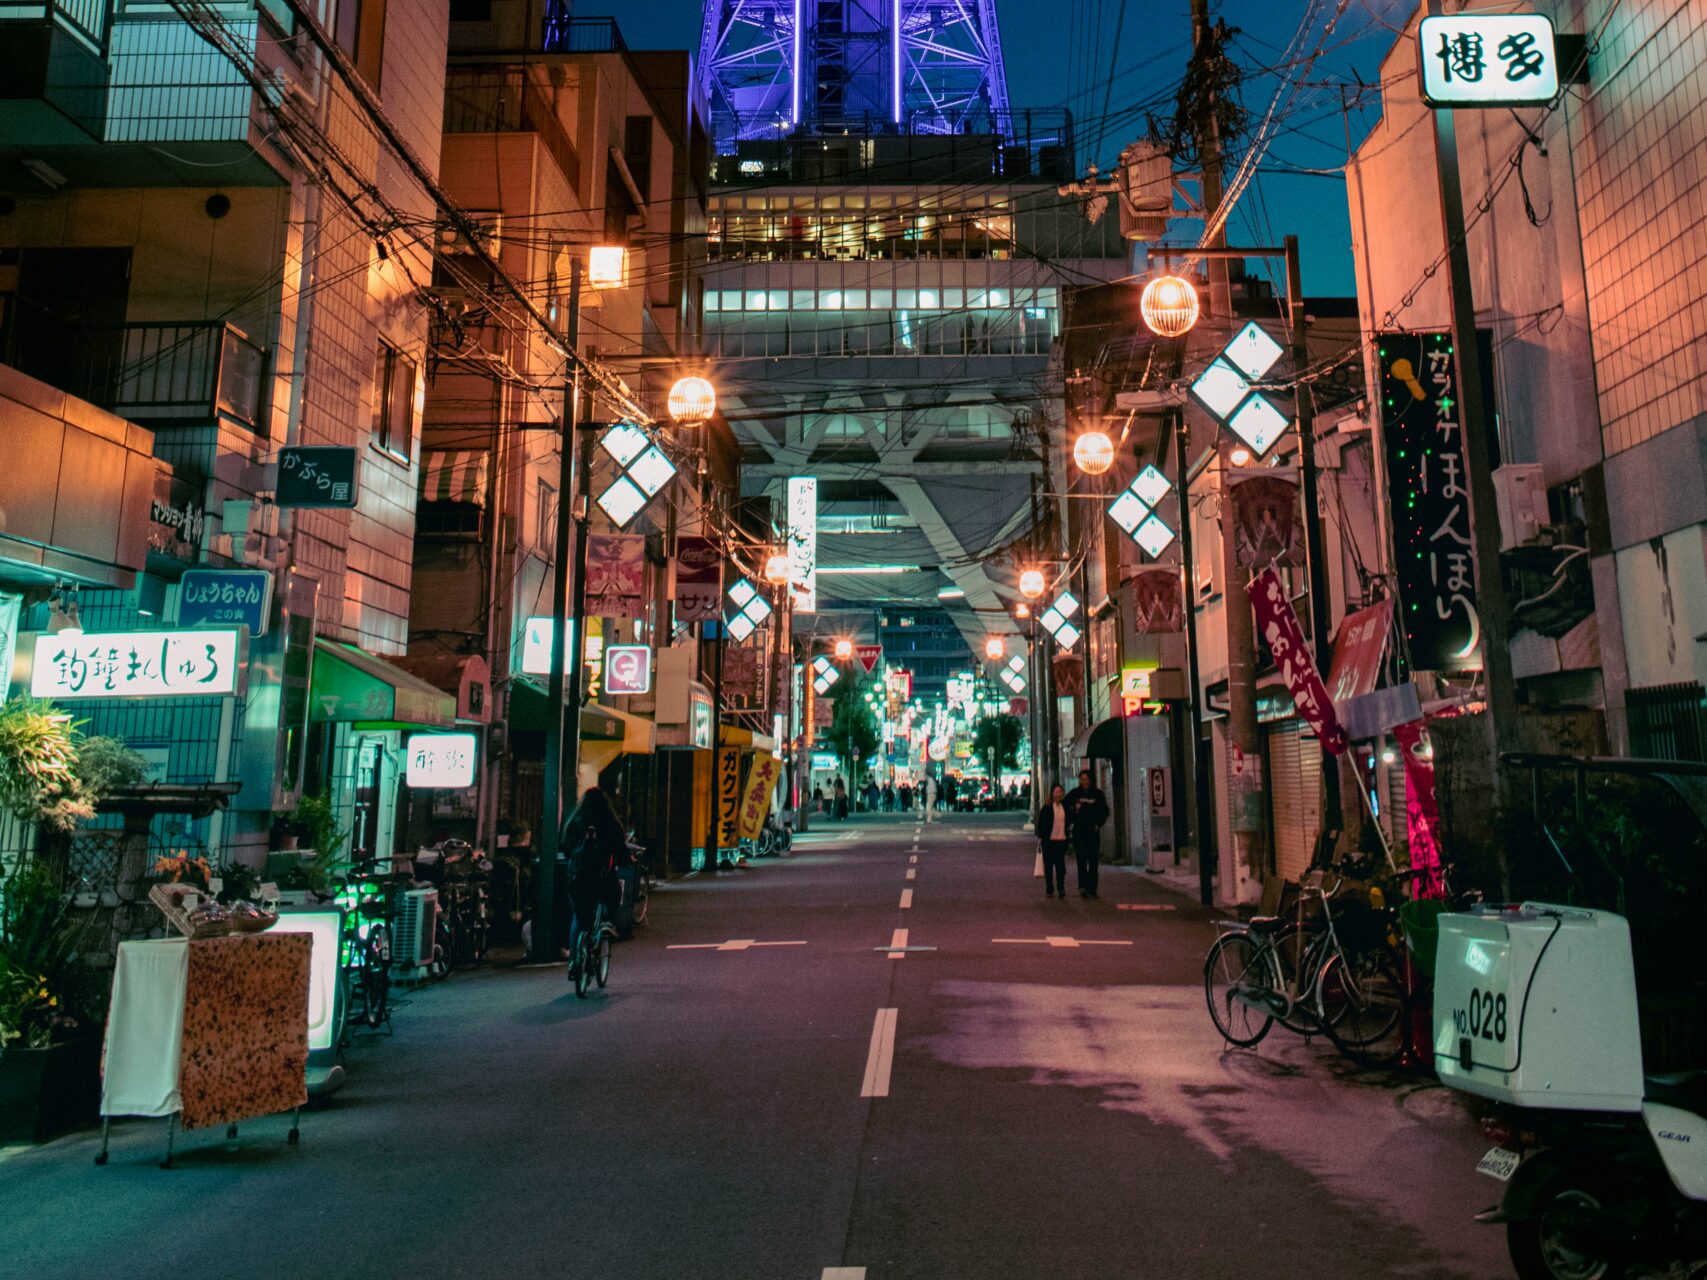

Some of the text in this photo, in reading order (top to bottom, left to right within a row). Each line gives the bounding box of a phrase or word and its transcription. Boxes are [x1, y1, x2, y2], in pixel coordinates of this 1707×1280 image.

[1436, 31, 1545, 84] 博多
[1427, 349, 1459, 444] カラオケ
[282, 452, 350, 501] かぶら屋
[185, 581, 260, 605] しょうちゃん
[1657, 1130, 1692, 1142] GEAR
